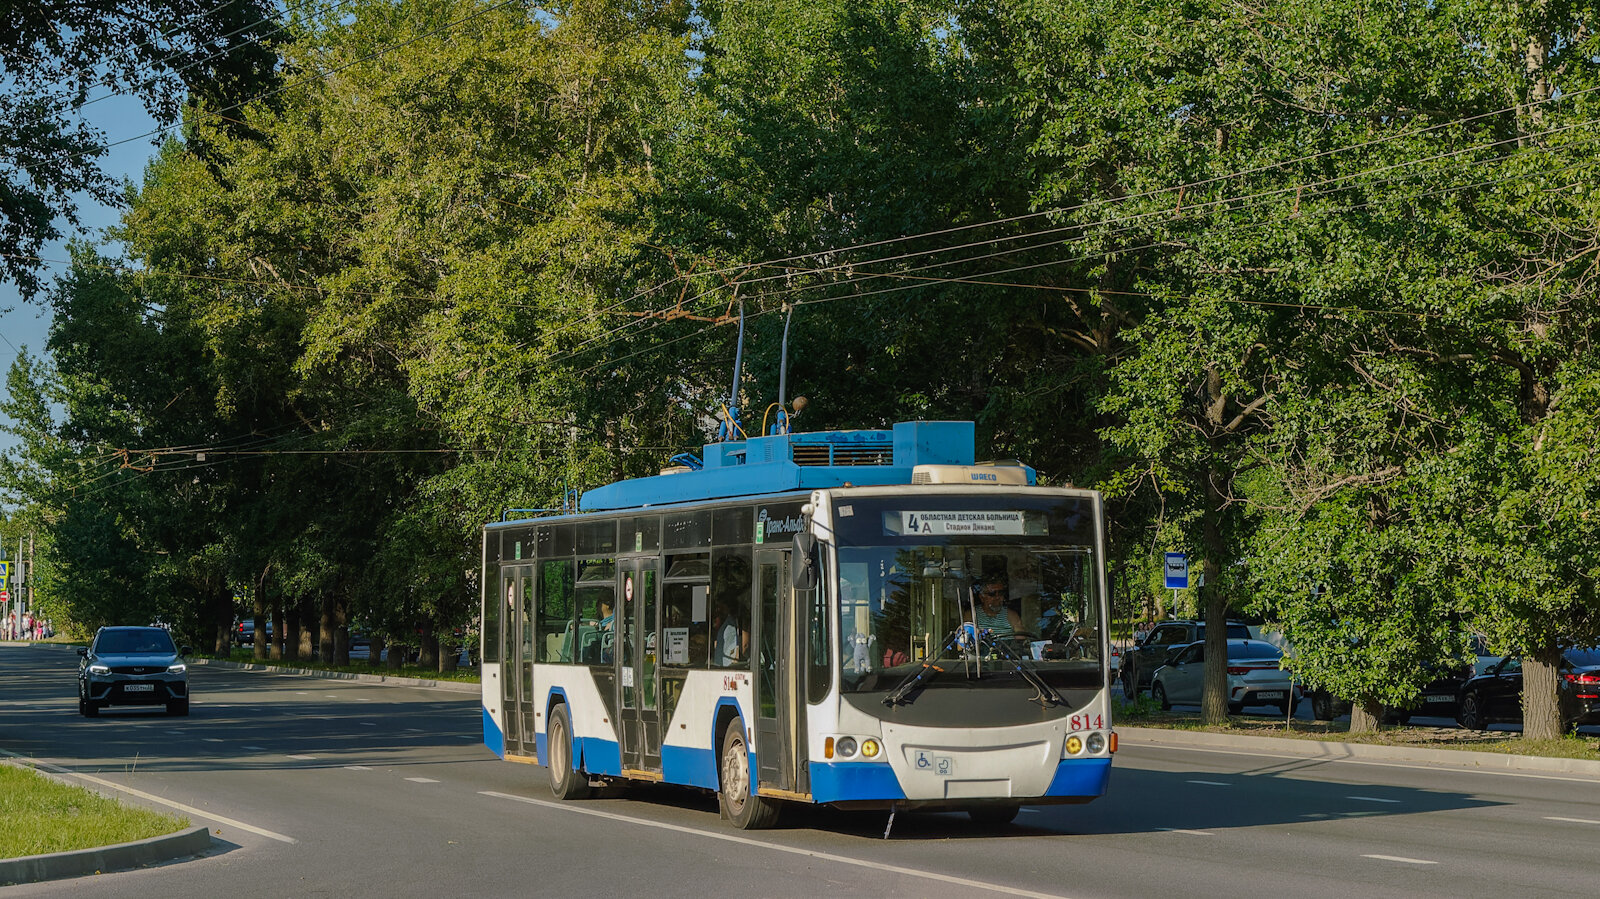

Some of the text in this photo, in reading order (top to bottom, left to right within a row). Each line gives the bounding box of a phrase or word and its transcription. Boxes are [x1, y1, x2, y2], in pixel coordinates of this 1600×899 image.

[765, 514, 804, 538] Транс-Альф
[908, 514, 919, 532] 4
[920, 513, 1020, 522] ОБЛАСТНАЯ ДЕТСКАЯ БОЛЬНИЦА
[945, 522, 995, 531] Стадион Динамо
[1071, 713, 1104, 731] 814
